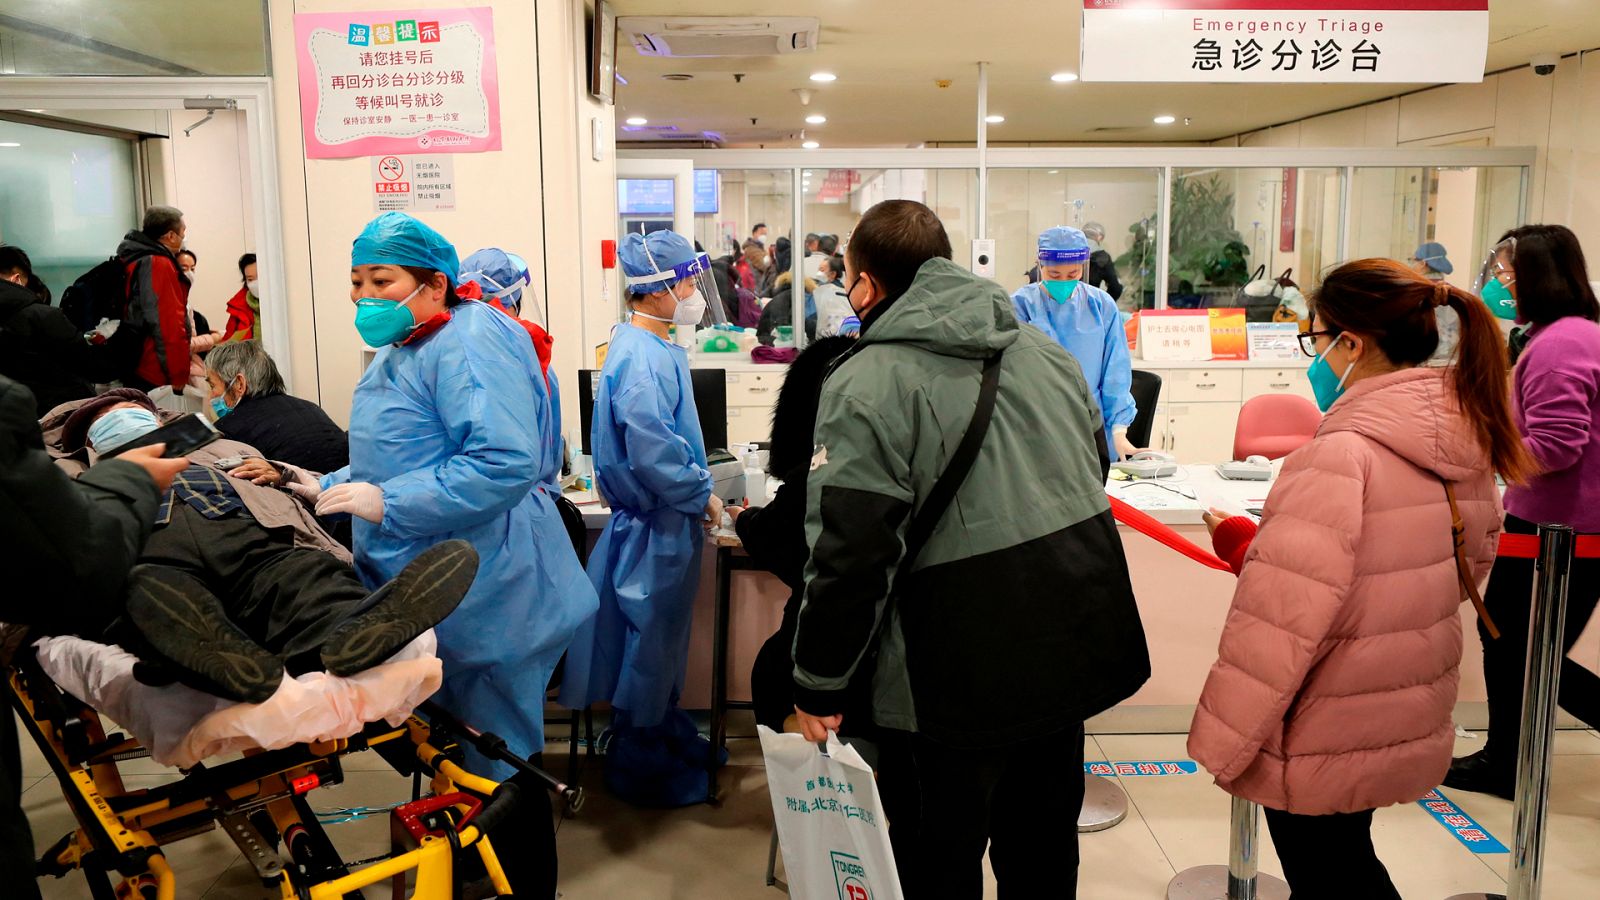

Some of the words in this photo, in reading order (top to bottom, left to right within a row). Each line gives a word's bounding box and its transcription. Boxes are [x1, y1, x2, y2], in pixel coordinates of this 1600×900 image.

[351, 23, 438, 43] 温馨提示
[1193, 18, 1307, 34] Emergency
[1318, 18, 1384, 34] Triage
[359, 50, 433, 67] 请您挂号后
[1191, 38, 1381, 72] 急诊分诊台
[331, 70, 465, 90] 再回分诊台分诊分级
[355, 93, 444, 111] 等候叫号就诊
[343, 115, 392, 126] 保持诊室安静
[400, 112, 459, 123] 一医一患一诊室
[377, 183, 408, 192] 禁止吸烟
[1084, 762, 1188, 775] 线后排队
